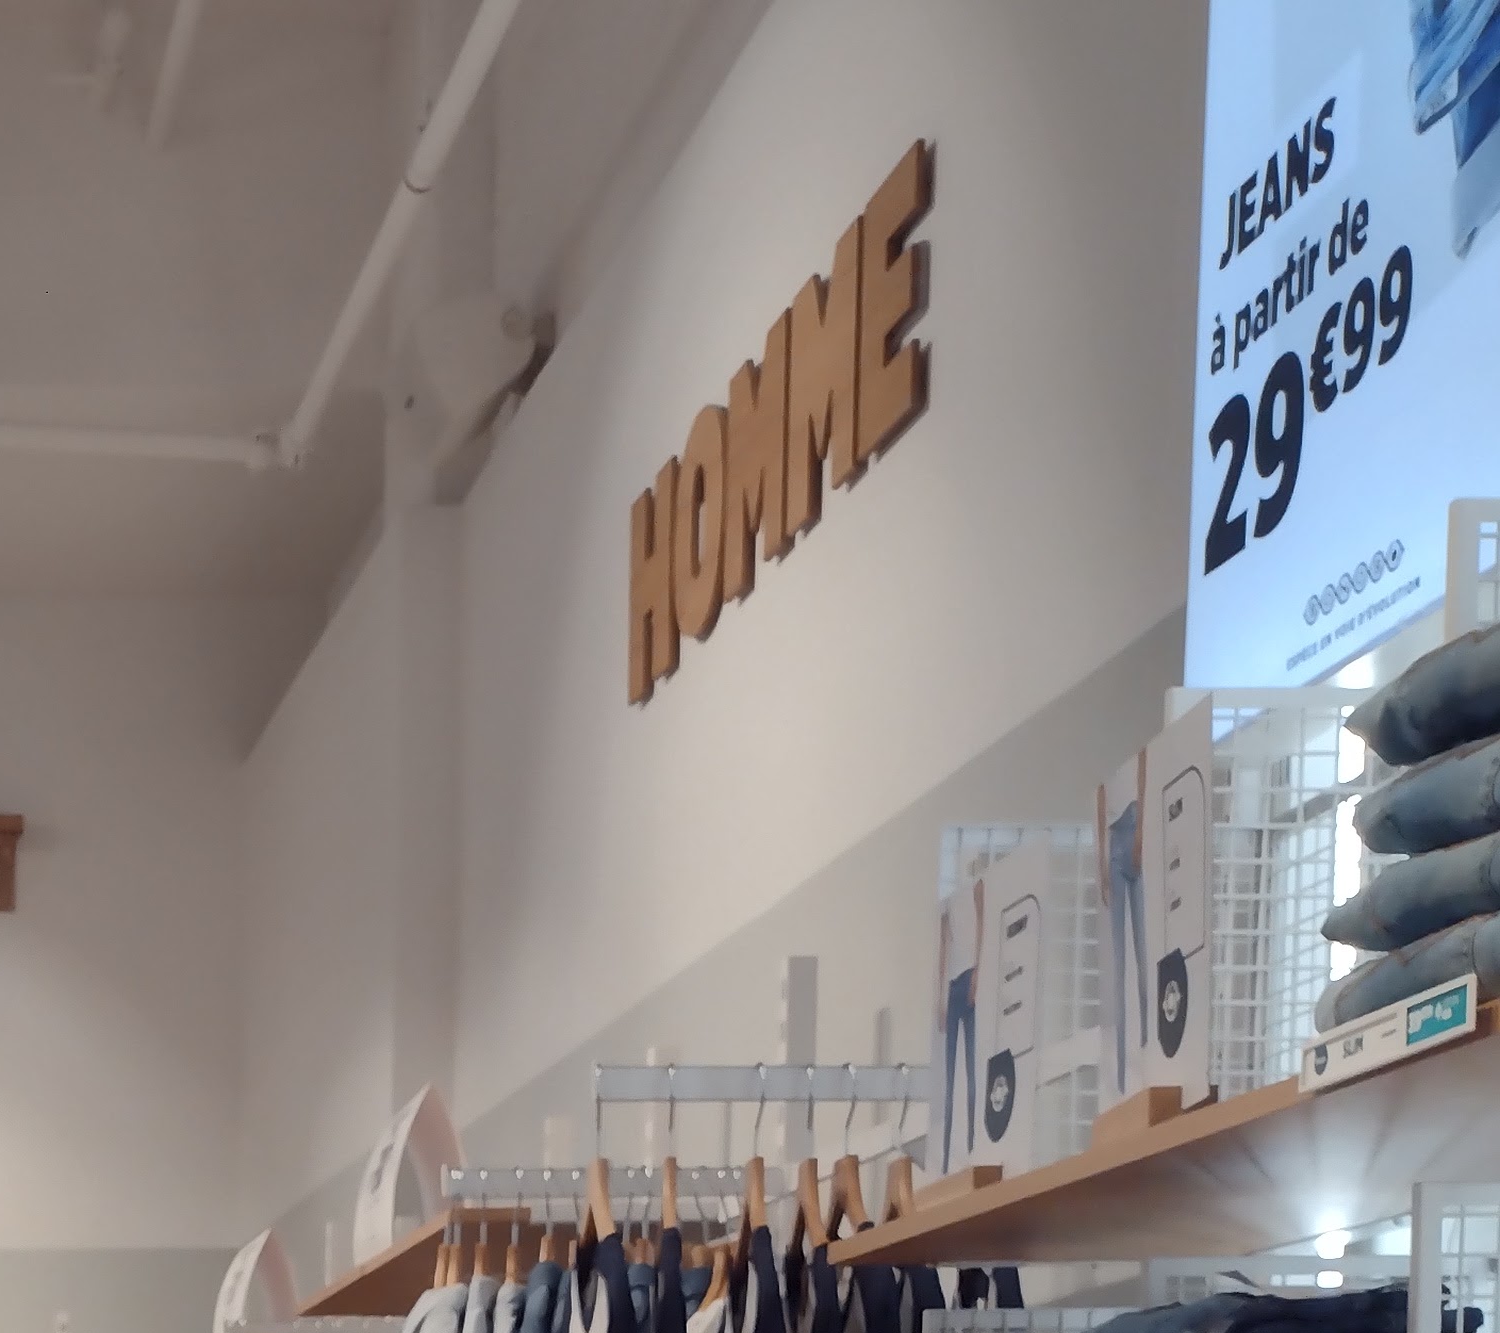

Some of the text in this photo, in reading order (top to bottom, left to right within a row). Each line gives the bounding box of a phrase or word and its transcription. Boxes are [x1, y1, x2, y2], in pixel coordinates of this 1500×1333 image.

[1219, 96, 1337, 271] JEANS
[1209, 197, 1370, 375] à partir de
[627, 138, 935, 706] HOMME
